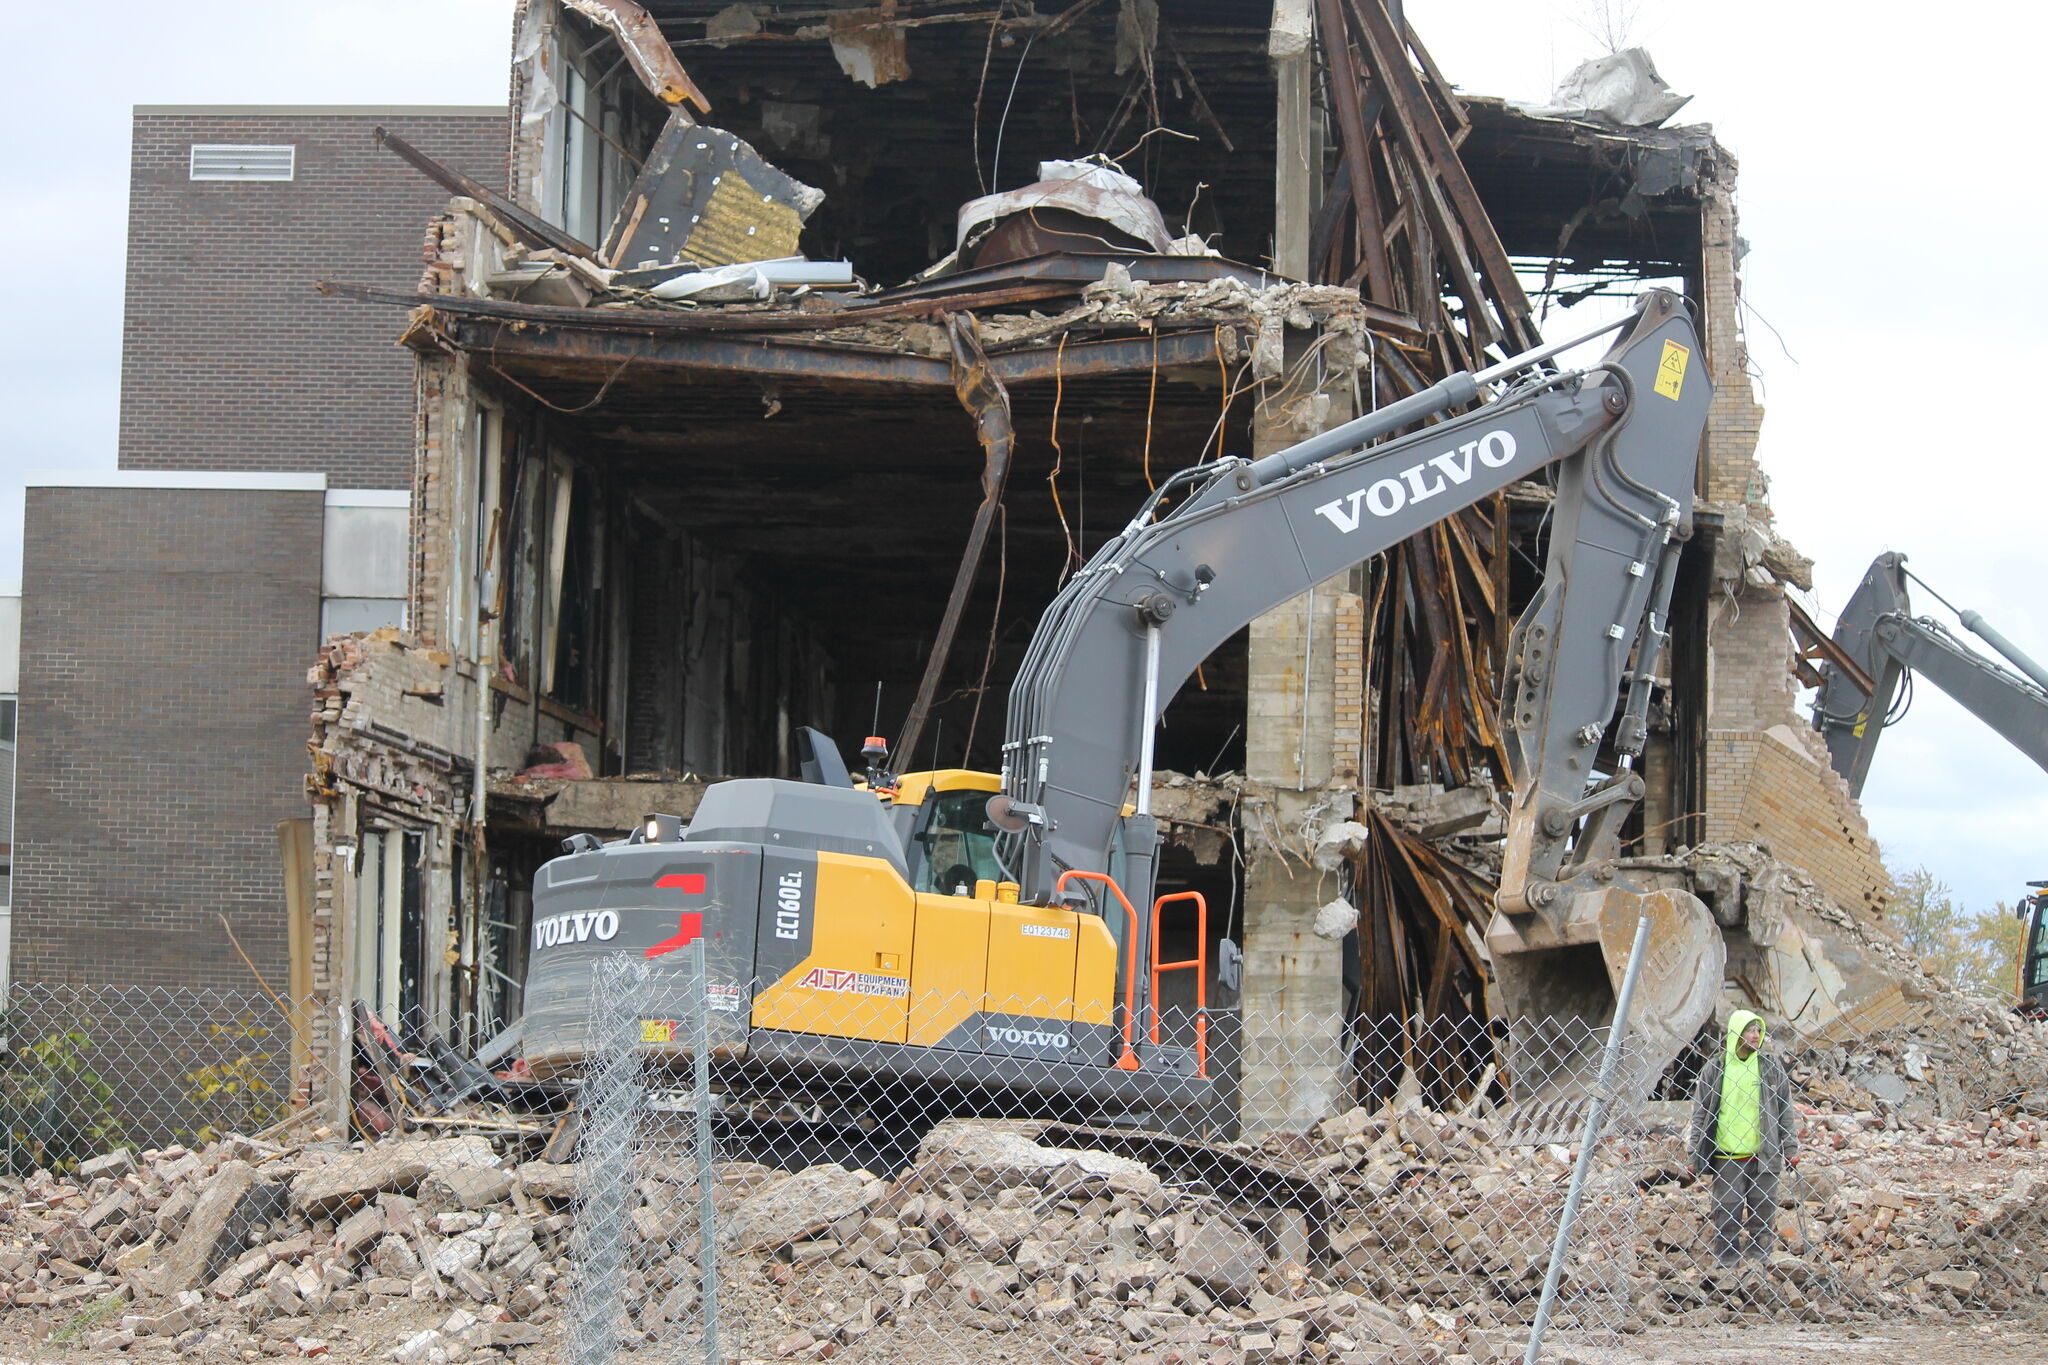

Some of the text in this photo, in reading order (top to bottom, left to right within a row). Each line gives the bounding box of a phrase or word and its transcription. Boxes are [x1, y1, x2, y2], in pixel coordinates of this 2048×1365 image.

[1314, 430, 1517, 534] VOLVO
[775, 871, 802, 940] EC160EL
[535, 910, 619, 950] VOLVO
[1022, 924, 1070, 938] EQ123748
[800, 968, 857, 992] ALTA
[858, 973, 907, 987] EQUIPMENT
[858, 983, 906, 998] COMPANY
[986, 1026, 1069, 1048] VOLVO
